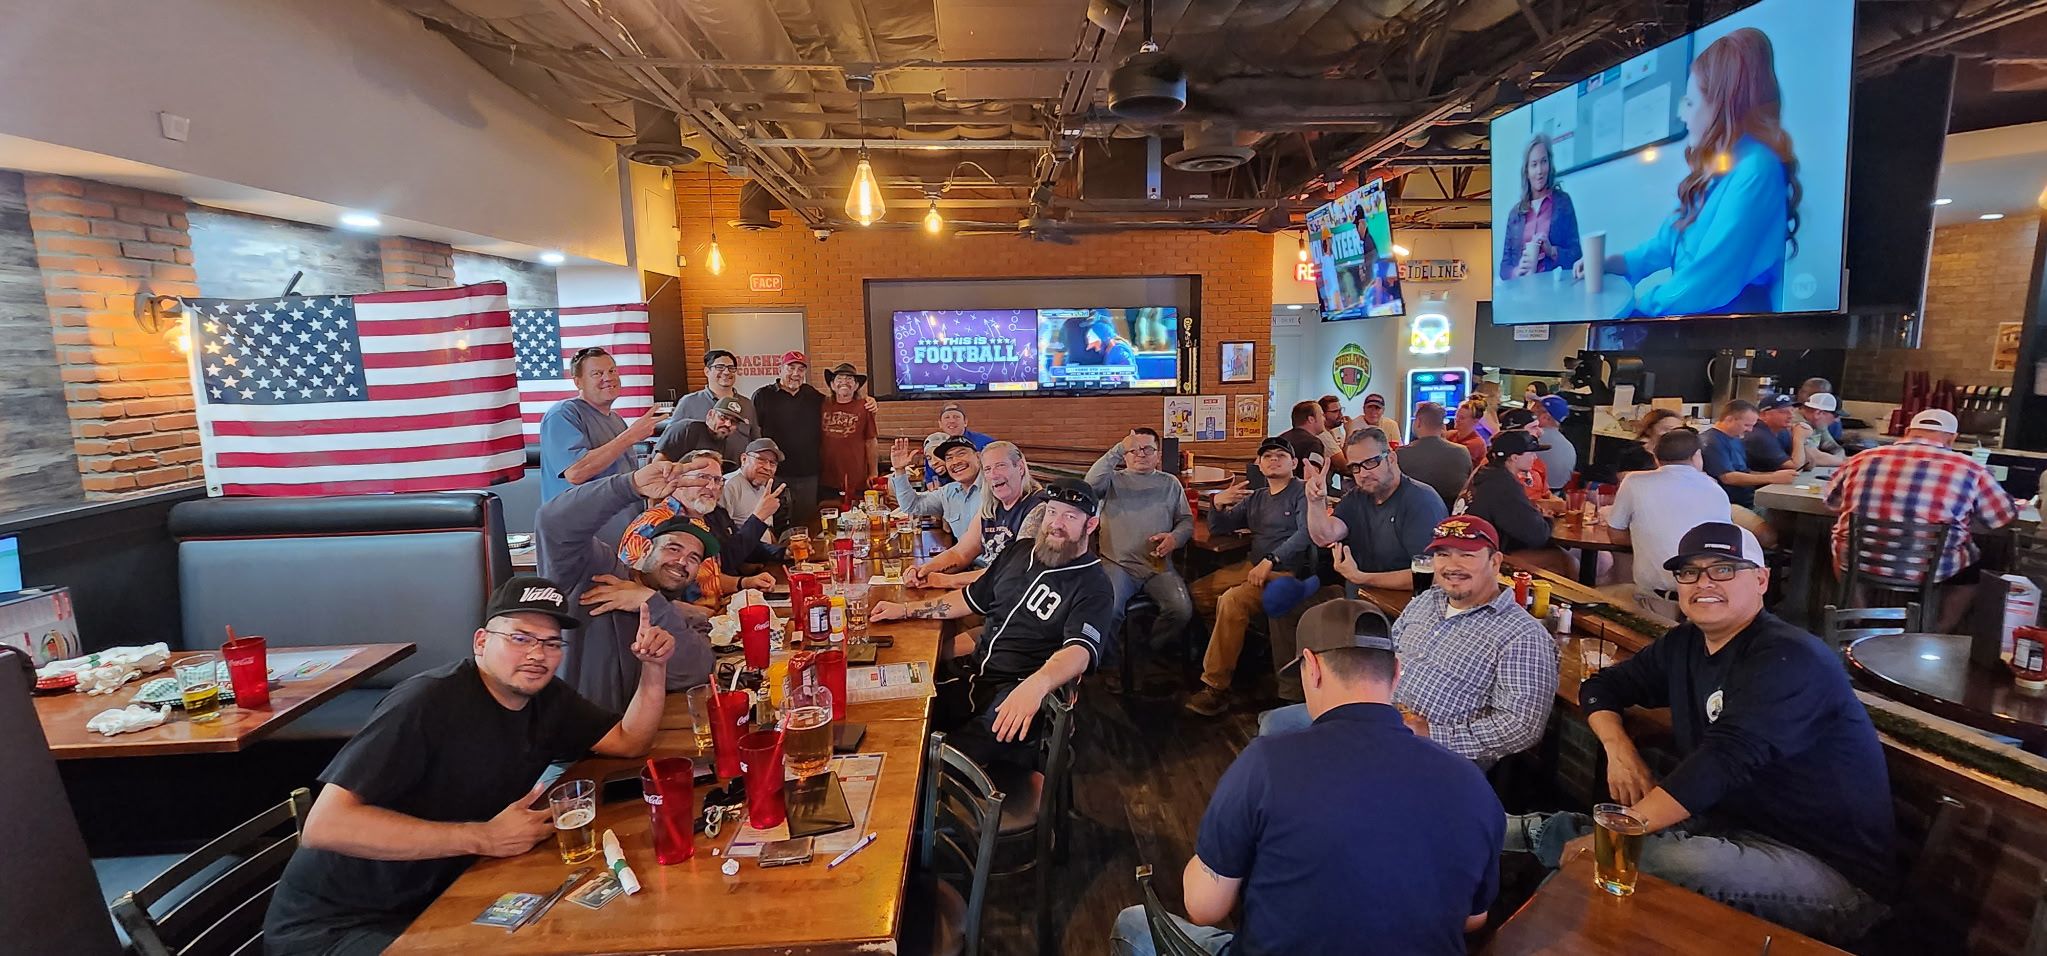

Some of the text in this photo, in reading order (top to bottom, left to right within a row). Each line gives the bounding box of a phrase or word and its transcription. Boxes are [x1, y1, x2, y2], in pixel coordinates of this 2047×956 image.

[1399, 262, 1467, 280] SIDELINES
[752, 277, 780, 289] FACP
[943, 336, 987, 346] THIS IS
[914, 345, 1019, 363] FOOTBALL
[519, 586, 563, 607] Valley
[1026, 583, 1062, 621] 03
